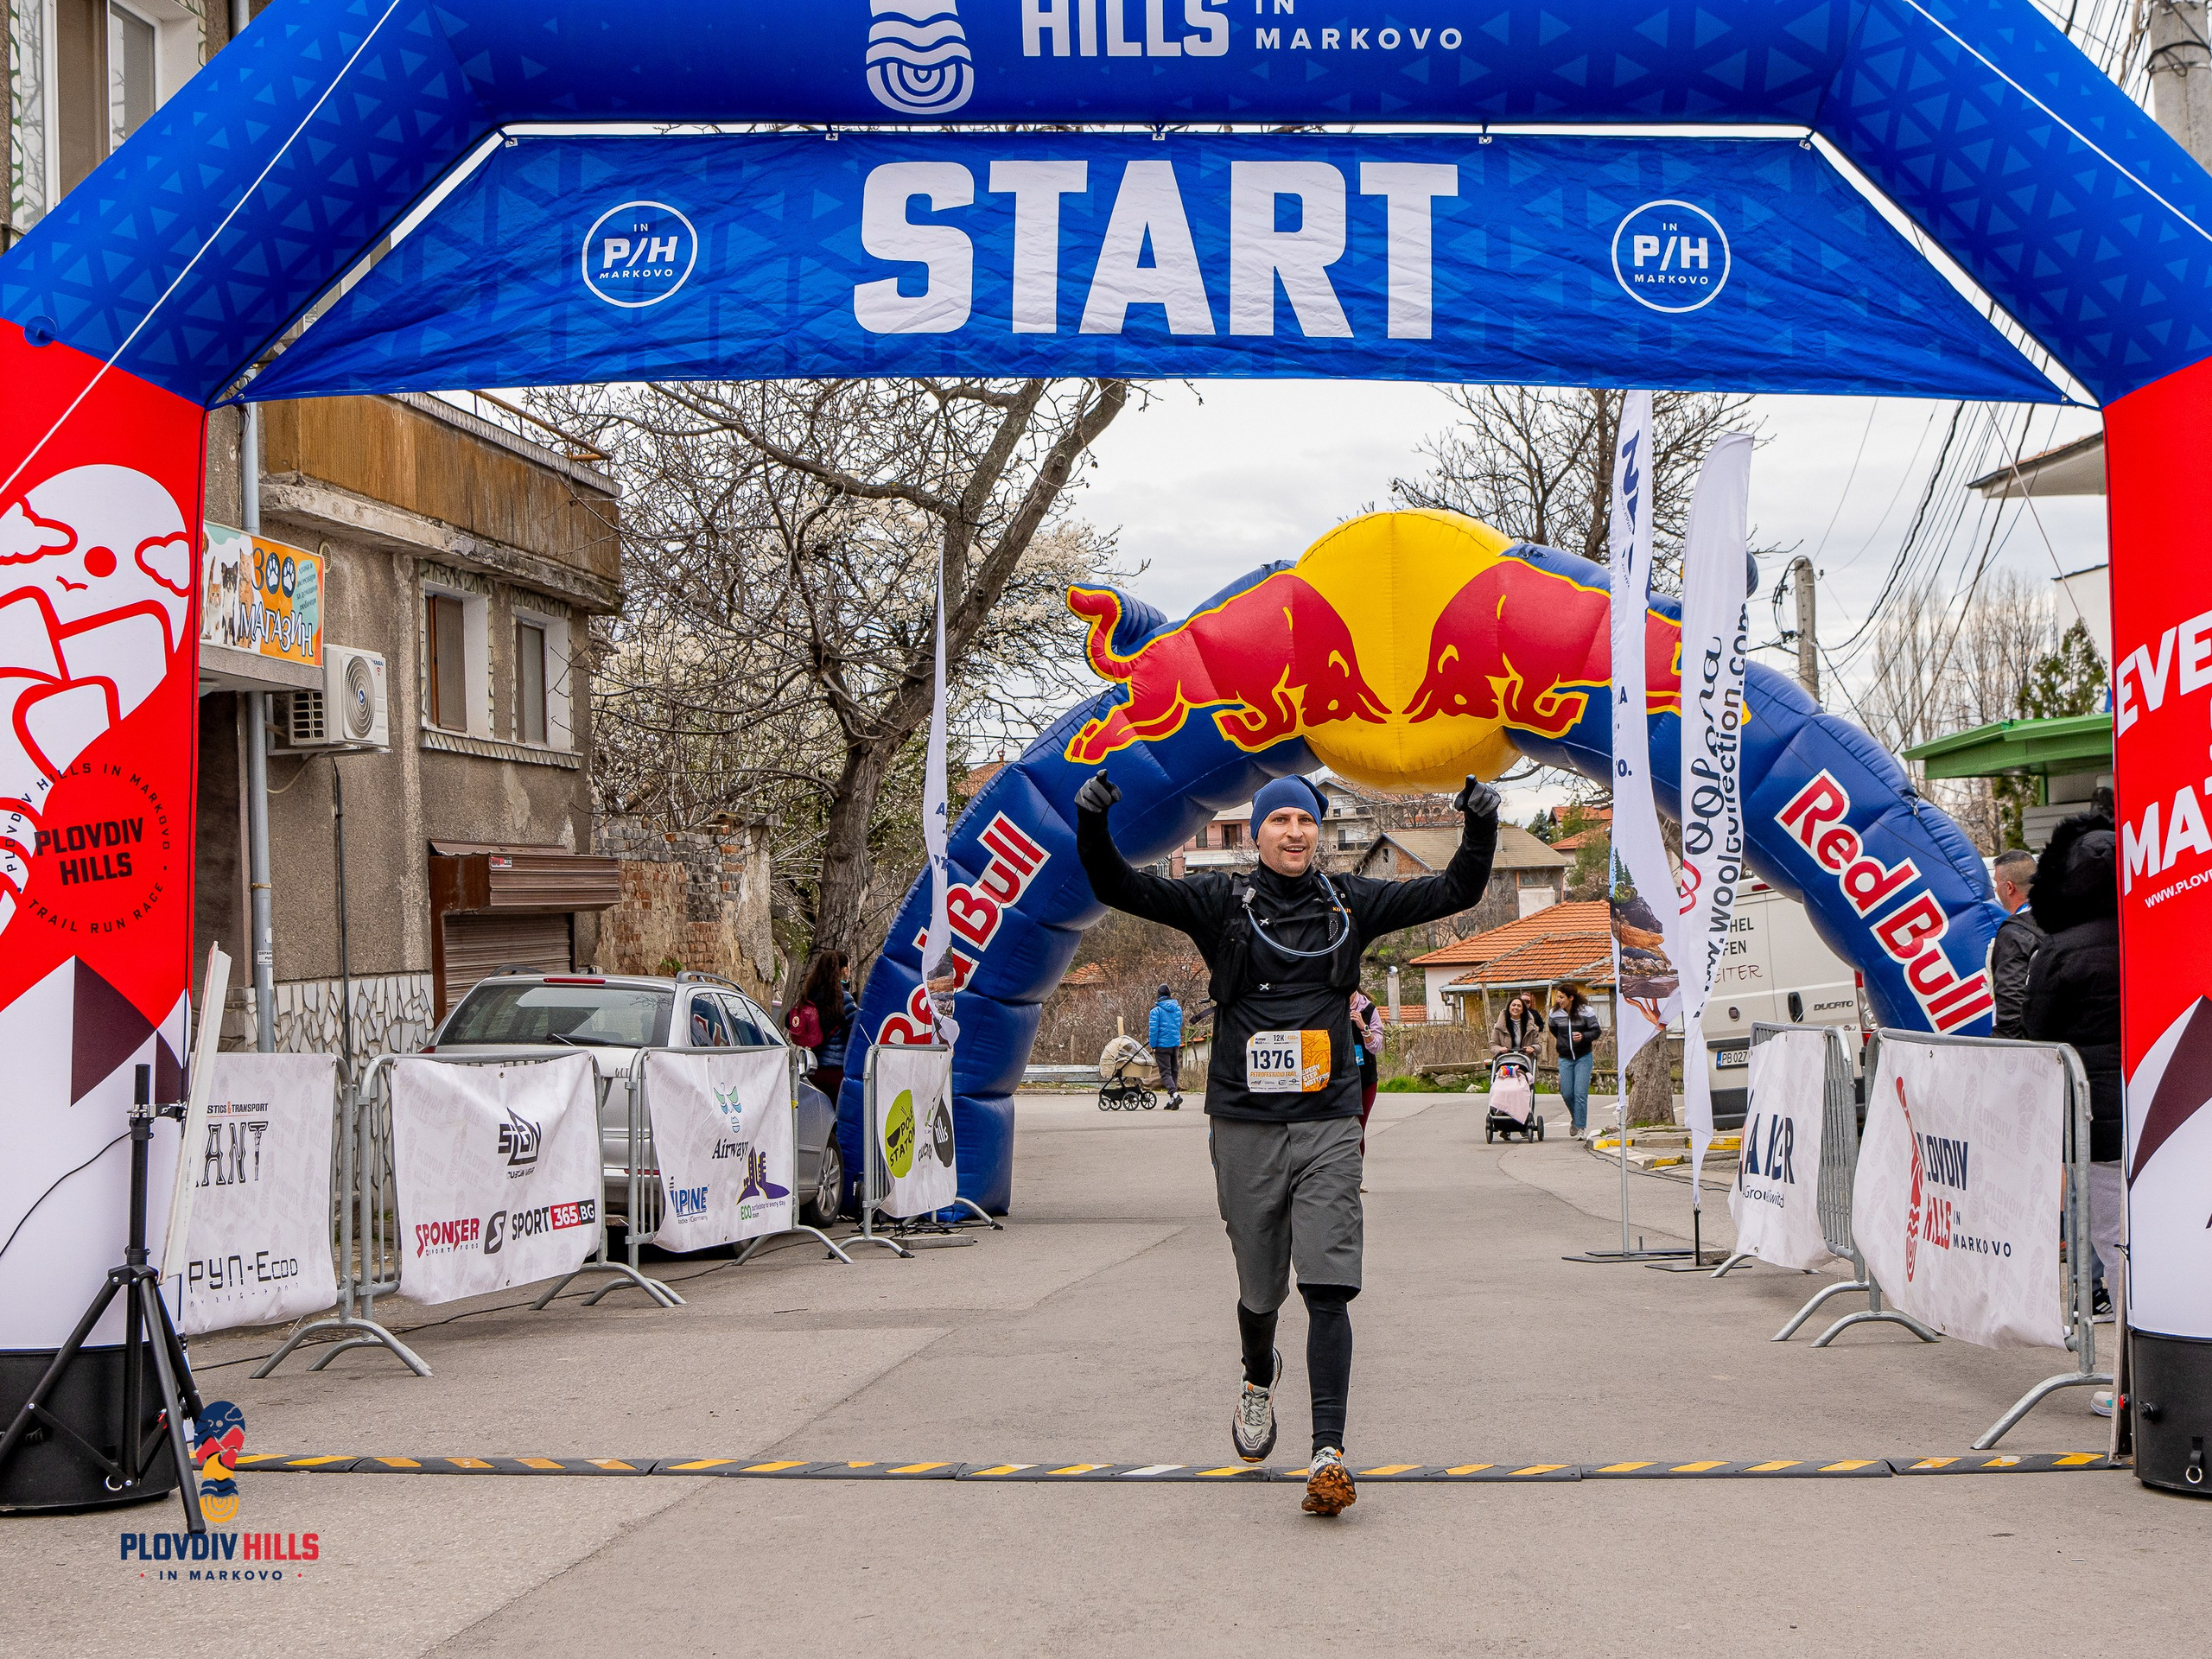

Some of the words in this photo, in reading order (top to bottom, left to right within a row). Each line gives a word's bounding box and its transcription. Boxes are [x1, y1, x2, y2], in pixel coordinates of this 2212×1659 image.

[1255, 0, 1295, 15] IN
[1022, 0, 1230, 57] HILLS
[1255, 28, 1463, 50] MARKOVO
[633, 223, 648, 232] IN
[603, 236, 678, 268] P/H
[854, 160, 1459, 340] START
[1634, 235, 1708, 271] P/H
[599, 269, 673, 279] MARKOVO
[1634, 274, 1708, 285] MARKOVO
[239, 601, 314, 657] МАГАЗИН
[5, 792, 33, 873] PLOVDIV
[36, 762, 92, 791] HILLS
[103, 763, 122, 777] IN
[130, 773, 170, 850] MARKOVO
[34, 817, 143, 856] PLOVDIV
[2122, 776, 2212, 897] MA
[59, 852, 133, 886] HILLS
[946, 817, 1045, 946] Bull
[1780, 775, 1916, 912] Red
[1876, 895, 1994, 1033] Bull
[2145, 868, 2212, 908] WWW.PLOV
[29, 899, 78, 932] TRAIL
[90, 918, 126, 934] RUN
[132, 882, 163, 920] RACE
[1814, 1000, 1854, 1011] DUCATO
[1250, 1049, 1295, 1070] 1376
[1733, 1052, 1747, 1063] 027
[232, 1103, 269, 1113] TRANSPORT
[196, 1121, 269, 1187] ANT
[1916, 1131, 1968, 1191] POVDIV
[512, 1206, 550, 1241] SPORT
[741, 1205, 753, 1220] ECO
[1953, 1210, 1961, 1225] IN
[415, 1217, 480, 1259] SPONSER
[1953, 1233, 2012, 1258] MARKOVO
